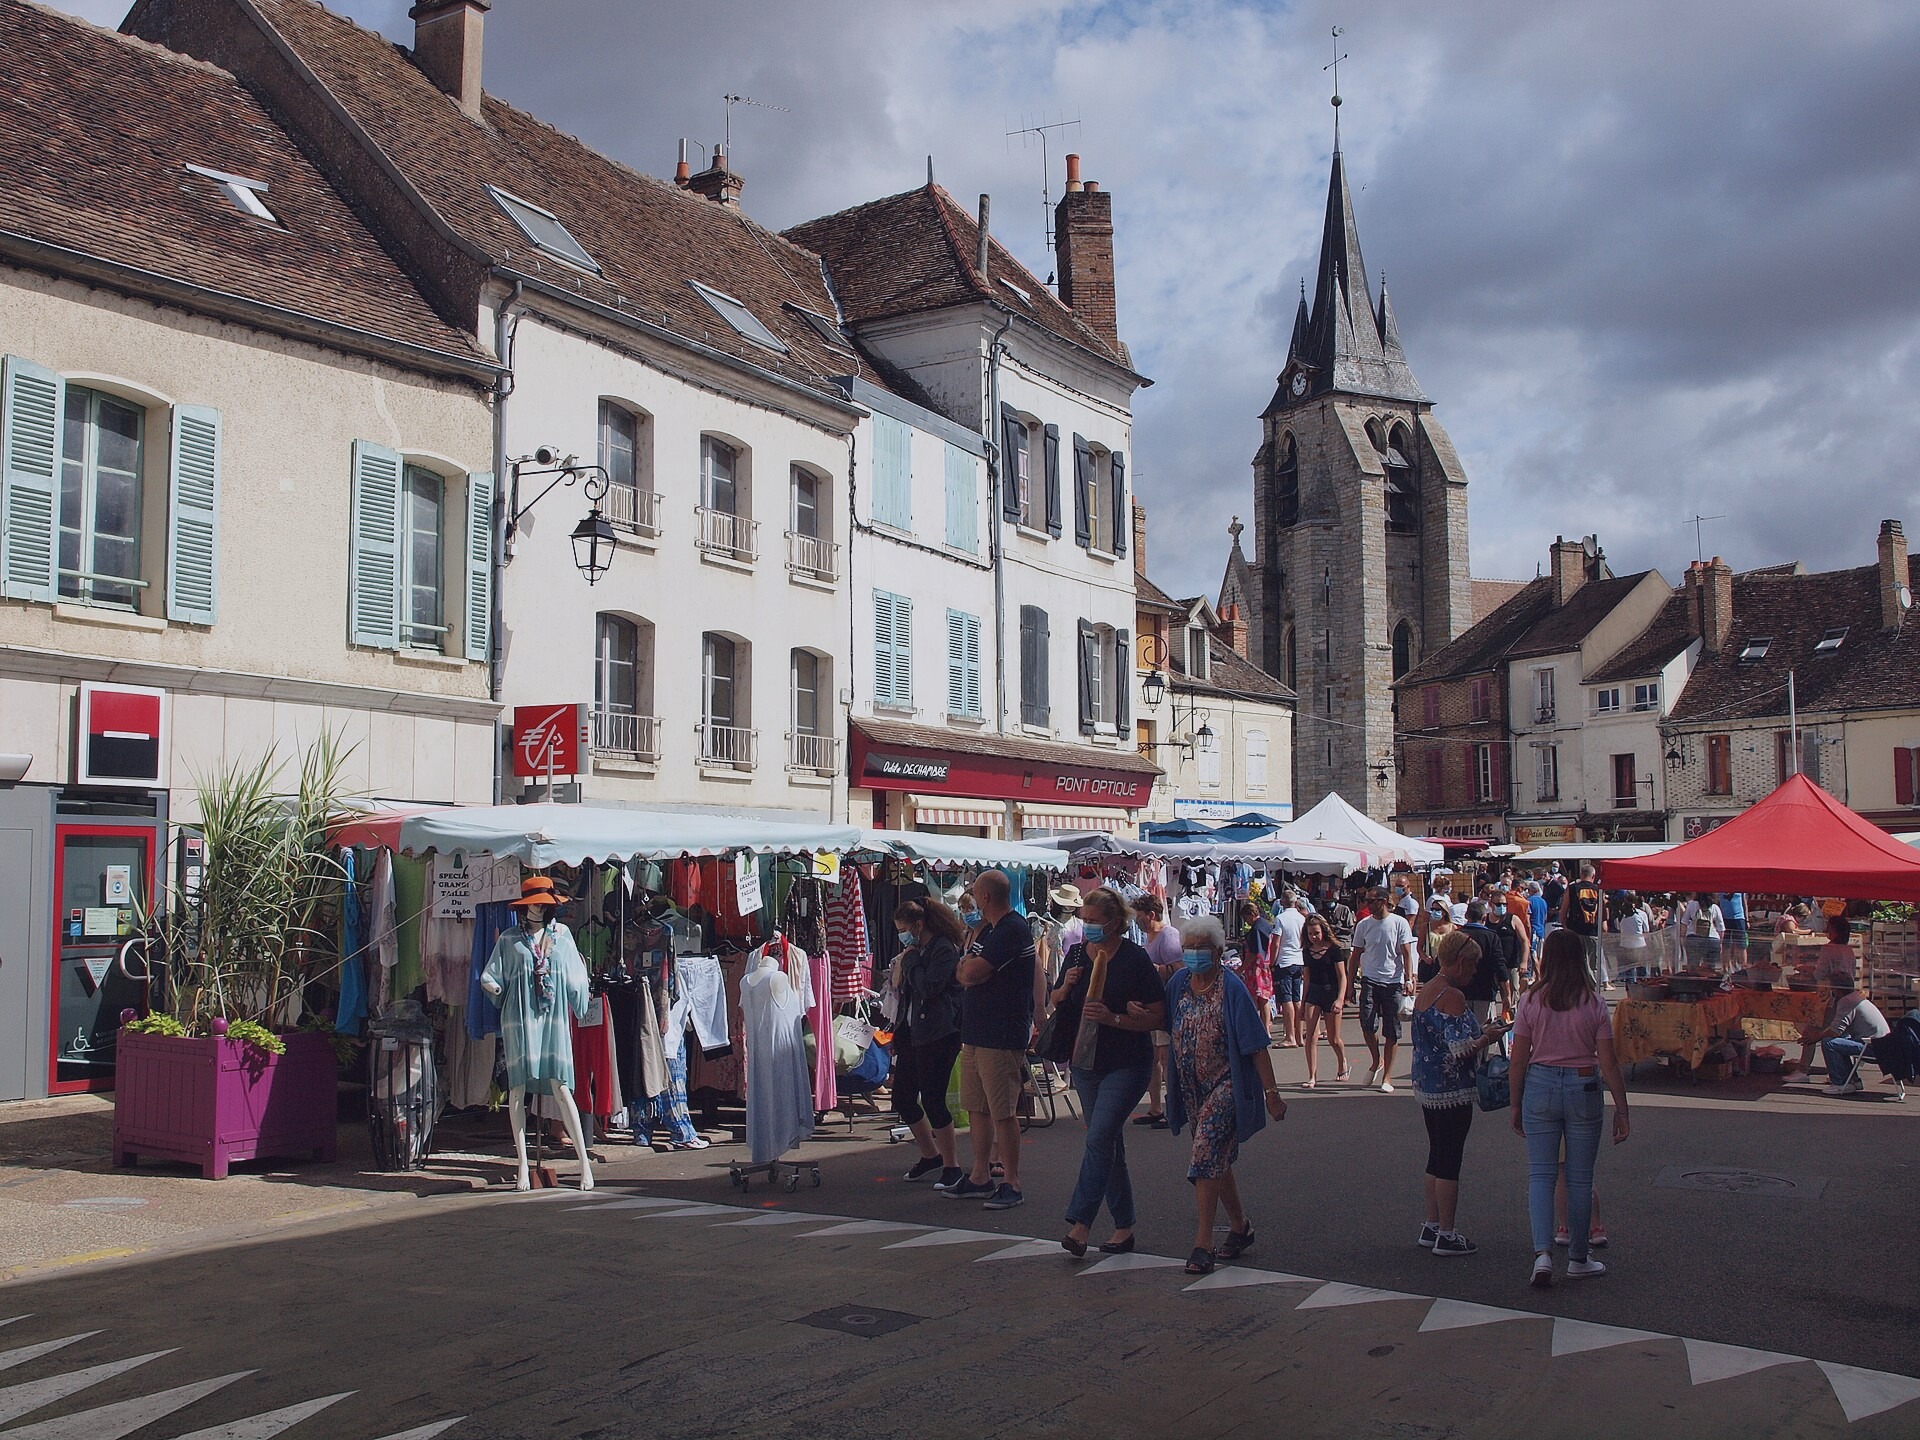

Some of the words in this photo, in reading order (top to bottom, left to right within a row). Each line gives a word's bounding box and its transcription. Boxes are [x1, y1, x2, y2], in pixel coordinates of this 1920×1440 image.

[883, 760, 902, 774] Odile
[902, 763, 948, 777] DECHAMBRE
[1056, 776, 1089, 792] PONT
[1091, 779, 1138, 796] OPTIQUE
[1442, 823, 1493, 837] COMMERCE
[1526, 828, 1543, 838] Pain
[471, 864, 519, 892] SOLDES
